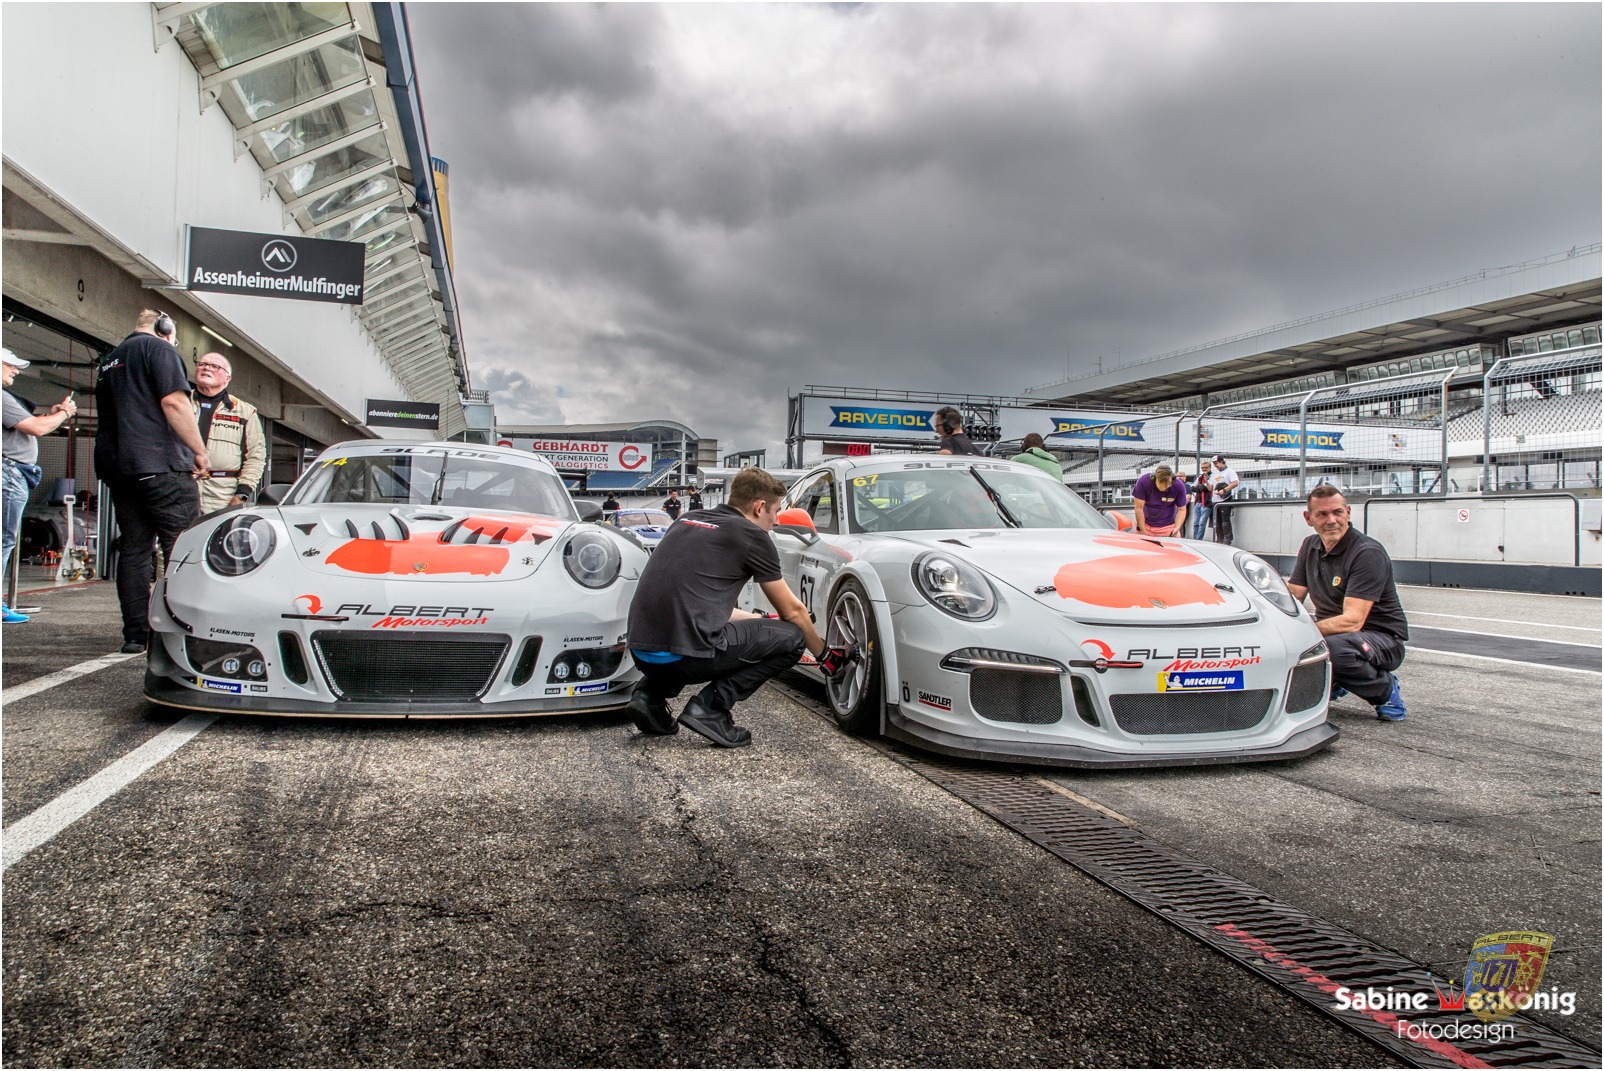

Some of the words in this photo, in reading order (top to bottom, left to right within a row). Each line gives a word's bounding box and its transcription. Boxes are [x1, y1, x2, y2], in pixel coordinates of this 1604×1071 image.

[193, 267, 361, 299] AssenheimerMulfinger
[78, 279, 84, 301] 9
[368, 409, 439, 420] abonnieredeinenstern.de
[839, 411, 927, 427] RAVENOL
[533, 441, 609, 453] GEBHARDT
[557, 454, 609, 462] GENERATION
[853, 474, 879, 487] 67
[801, 574, 815, 612] 67
[335, 604, 495, 618] ALBERT
[371, 616, 490, 629] Motorsport
[209, 627, 256, 638] KLASEN-MOTORS
[563, 635, 604, 643] KLASEN-MOTORS
[1127, 645, 1261, 660] ALBERT
[1163, 655, 1262, 673] Motorsport
[208, 682, 239, 691] MICHELIN
[1183, 676, 1236, 687] MICHELIN
[581, 684, 606, 693] MICHELIN
[919, 690, 952, 707] SANDTLER
